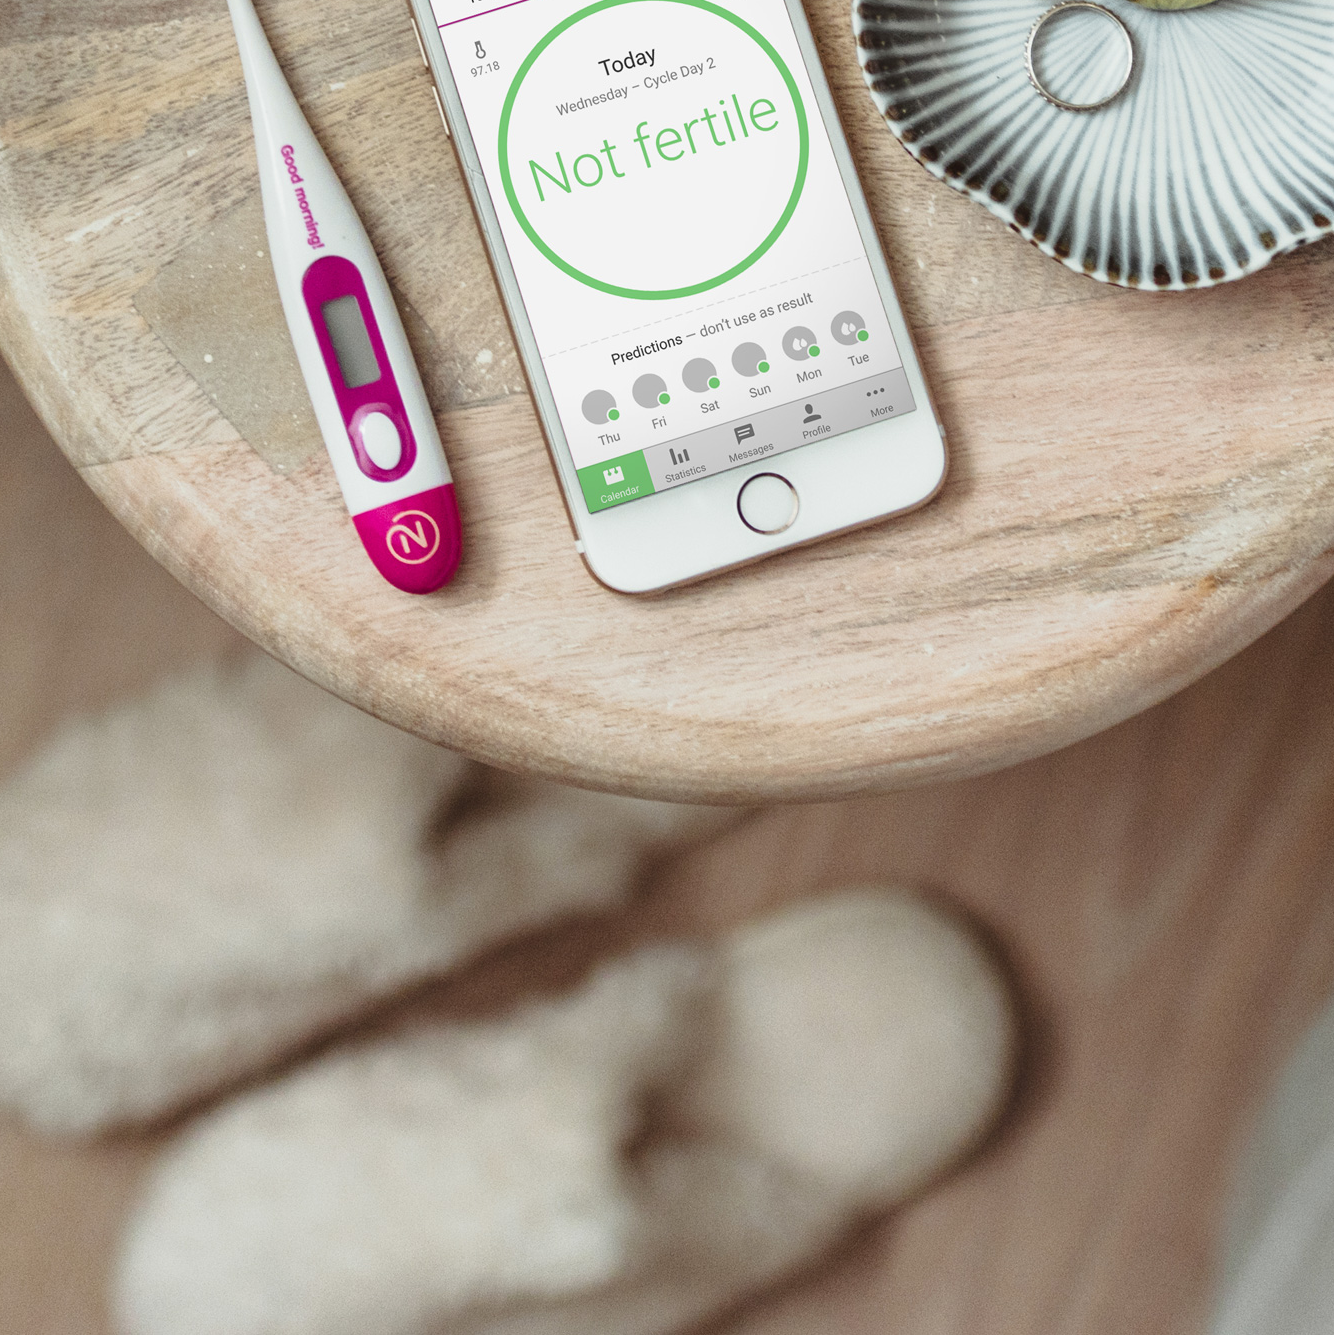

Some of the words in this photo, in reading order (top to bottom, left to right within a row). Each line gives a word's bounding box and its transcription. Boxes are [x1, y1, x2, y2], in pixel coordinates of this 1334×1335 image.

[470, 61, 501, 78] 97.18
[598, 47, 657, 76] Today
[555, 83, 628, 116] Wednesday
[643, 69, 678, 91] Cycle
[680, 64, 705, 82] Day
[706, 57, 716, 69] 2
[528, 139, 626, 202] Not
[633, 94, 779, 169] fertile
[280, 144, 303, 185] Good
[295, 186, 324, 250] morning!
[611, 333, 683, 365] Predictions
[733, 310, 757, 326] use
[759, 305, 775, 319] as
[777, 292, 814, 314] result
[848, 353, 869, 367] Tue
[796, 368, 822, 384] Mon
[749, 383, 771, 399] Sun
[700, 400, 720, 414] Sat
[870, 404, 894, 418] More
[651, 416, 667, 430] Fri
[802, 424, 831, 439] Profile
[598, 431, 621, 447] Thu
[729, 443, 774, 463] Messages
[665, 464, 707, 484] Statistics
[600, 485, 640, 504] Calendar
